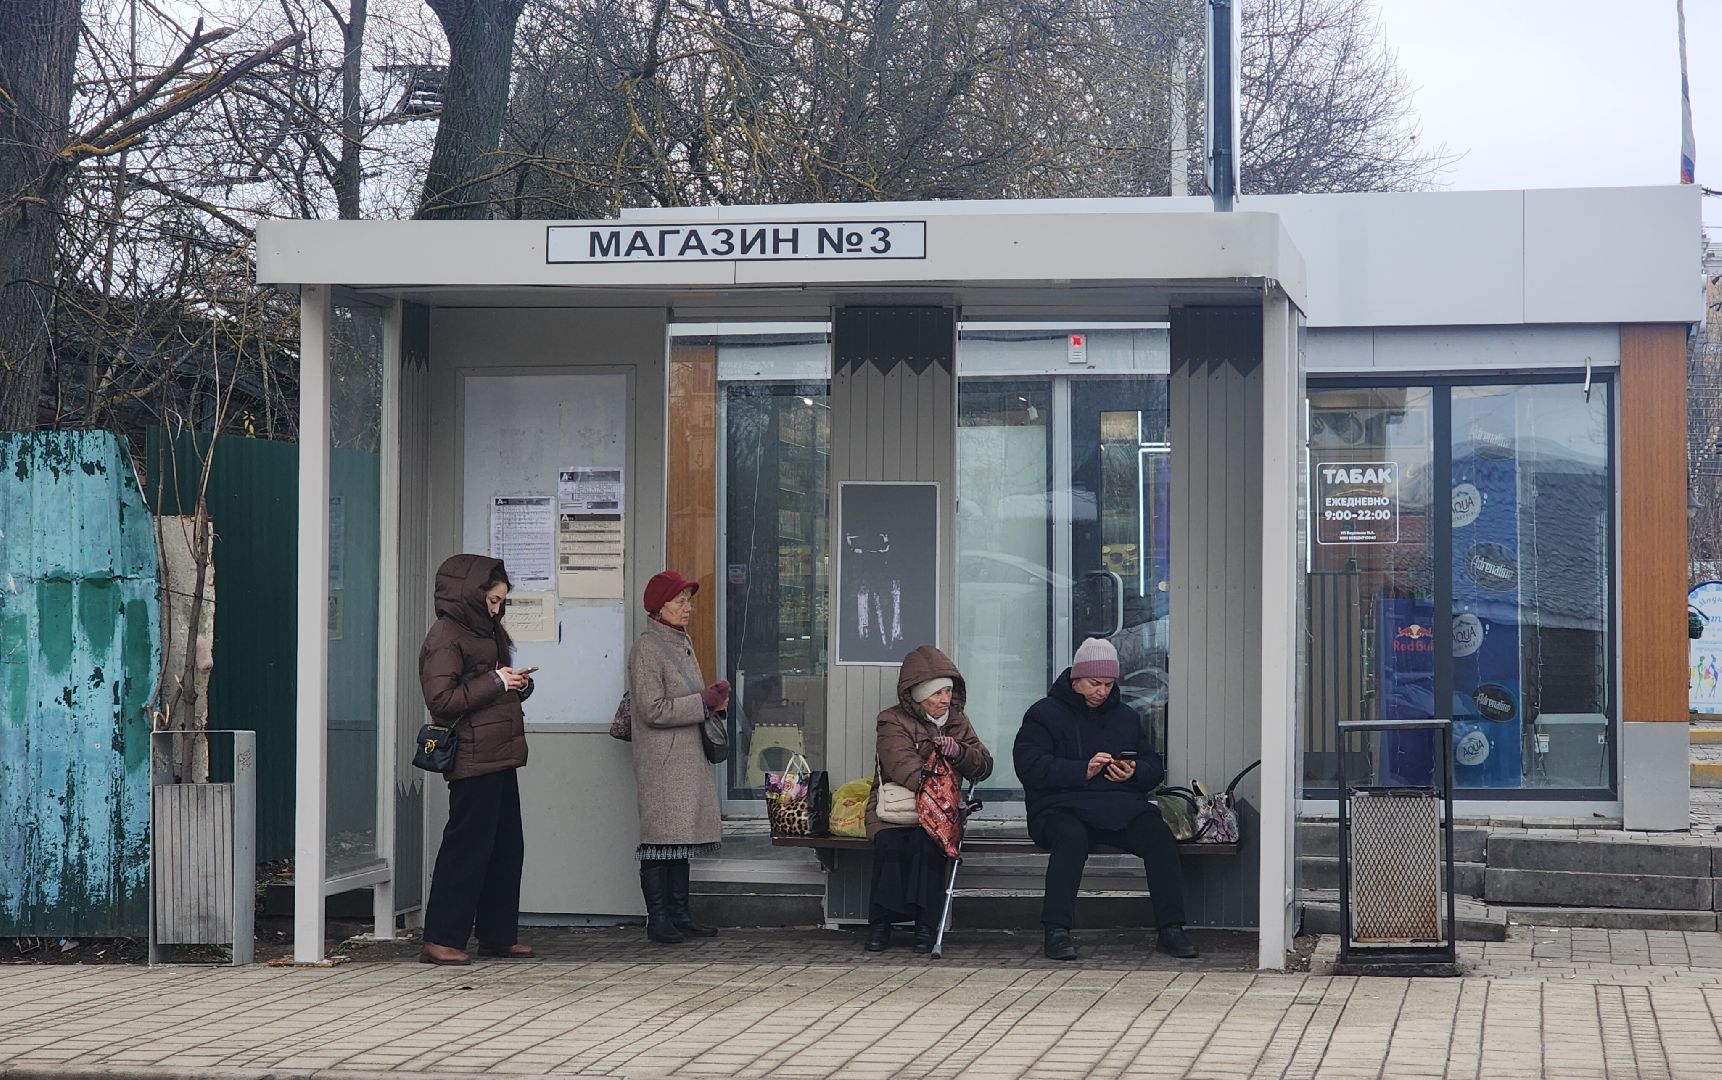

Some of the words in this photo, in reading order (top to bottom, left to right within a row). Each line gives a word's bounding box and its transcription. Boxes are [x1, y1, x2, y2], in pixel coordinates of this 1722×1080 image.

[588, 228, 799, 258] МАГАЗИН
[817, 226, 892, 255] №3
[1323, 468, 1393, 485] ТАБАК
[1325, 496, 1390, 508] ЕЖЕДНЕВНО
[1324, 510, 1391, 521] 9:00-22:00
[1393, 639, 1415, 652] Red
[1463, 739, 1485, 758] AQUA
